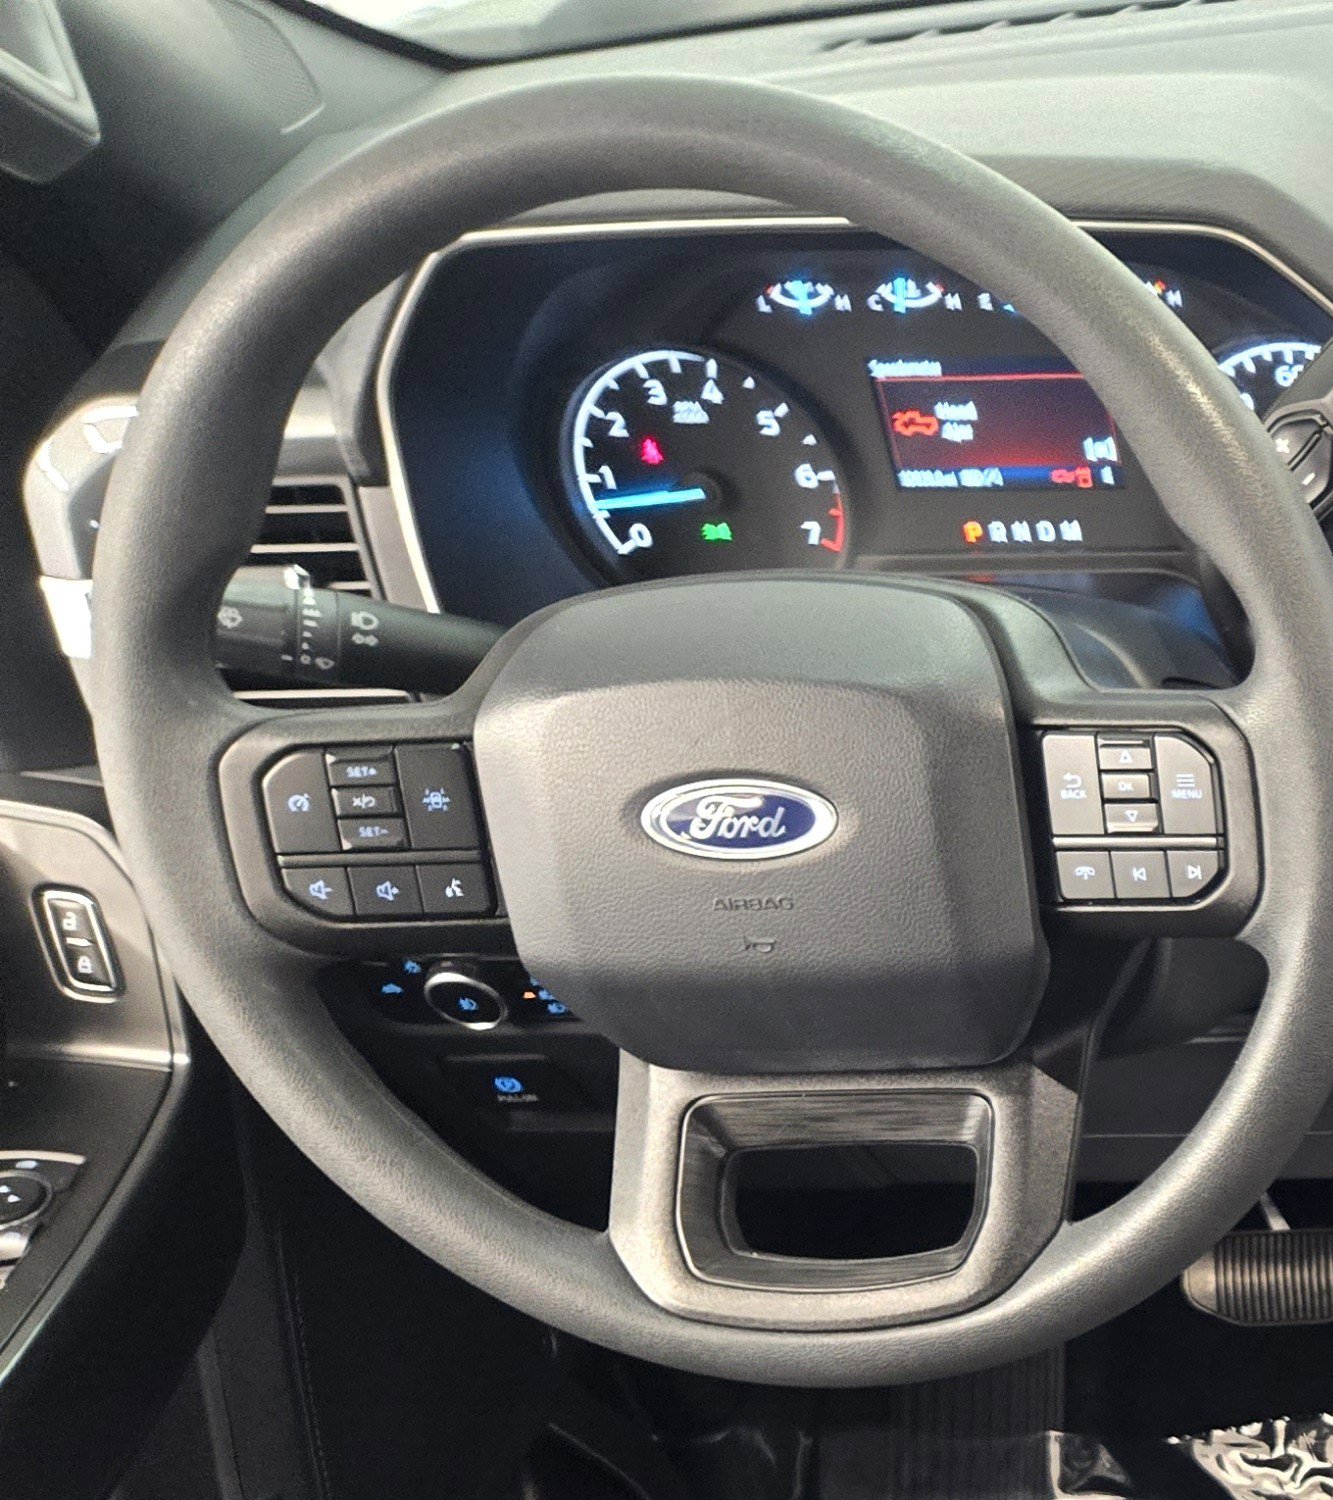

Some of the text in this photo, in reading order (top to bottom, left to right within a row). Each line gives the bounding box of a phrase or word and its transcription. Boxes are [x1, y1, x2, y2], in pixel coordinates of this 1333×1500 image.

[643, 379, 667, 405] 3
[701, 379, 723, 404] 4
[605, 411, 629, 437] 2
[756, 410, 780, 436] 5
[600, 465, 616, 490] 1
[794, 463, 818, 489] 6
[629, 522, 653, 548] 0
[800, 520, 820, 546] 7
[963, 520, 983, 542] P
[1035, 520, 1056, 542] D
[1060, 789, 1087, 800] BACK
[1118, 782, 1134, 792] OK
[1171, 789, 1203, 800] MENU
[681, 794, 787, 841] Ford
[713, 897, 795, 911] AIRBAG
